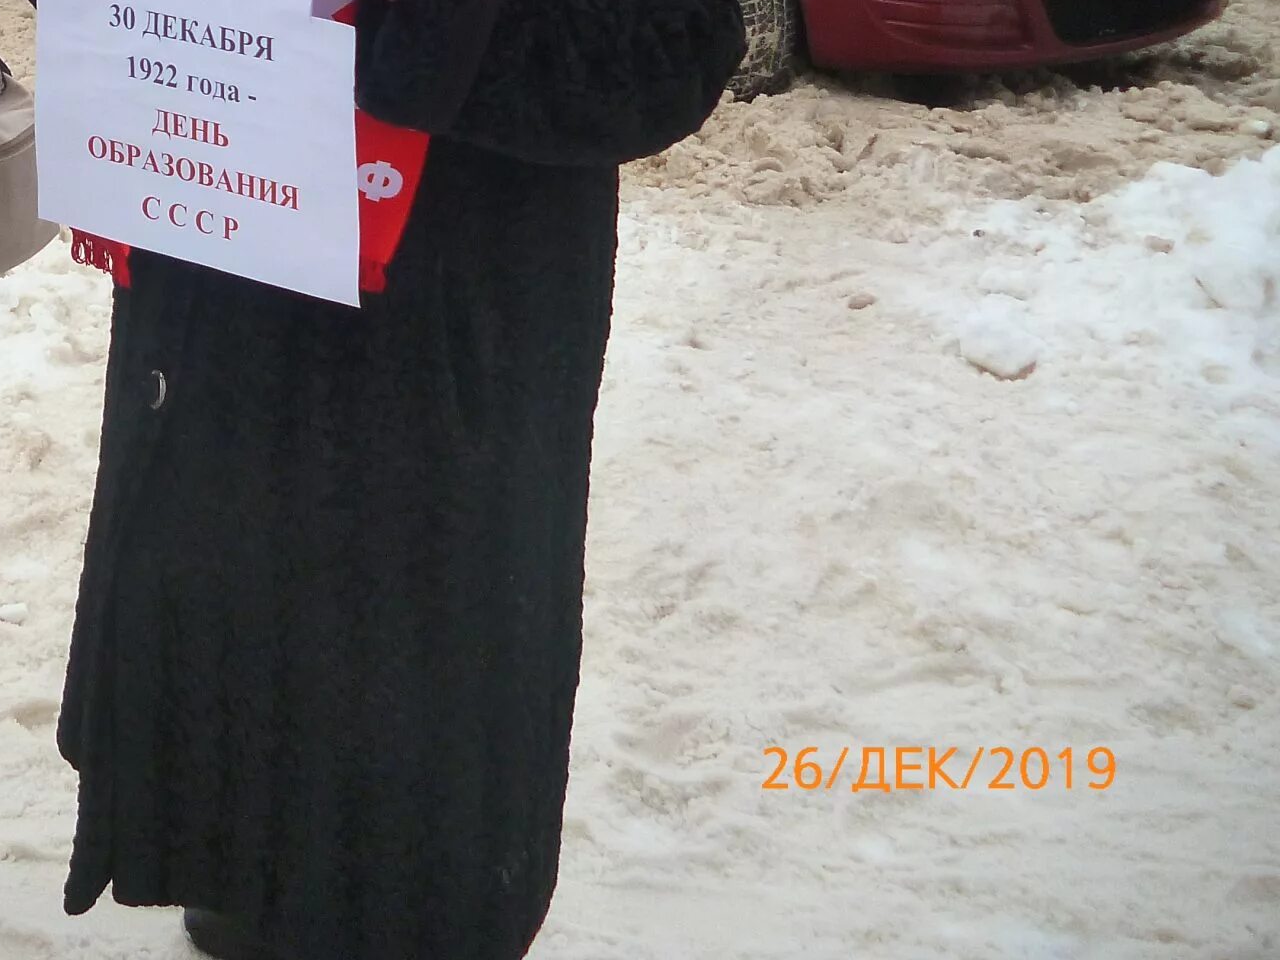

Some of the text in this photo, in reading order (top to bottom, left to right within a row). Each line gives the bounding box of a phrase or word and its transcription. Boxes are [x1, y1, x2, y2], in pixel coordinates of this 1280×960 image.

[108, 3, 275, 62] 30 ДЕКАБРЯ
[127, 56, 178, 89] 1922
[186, 73, 241, 103] года
[152, 108, 230, 148] ДЕНЬ
[87, 135, 300, 211] ОБРАЗОВАНИЯ
